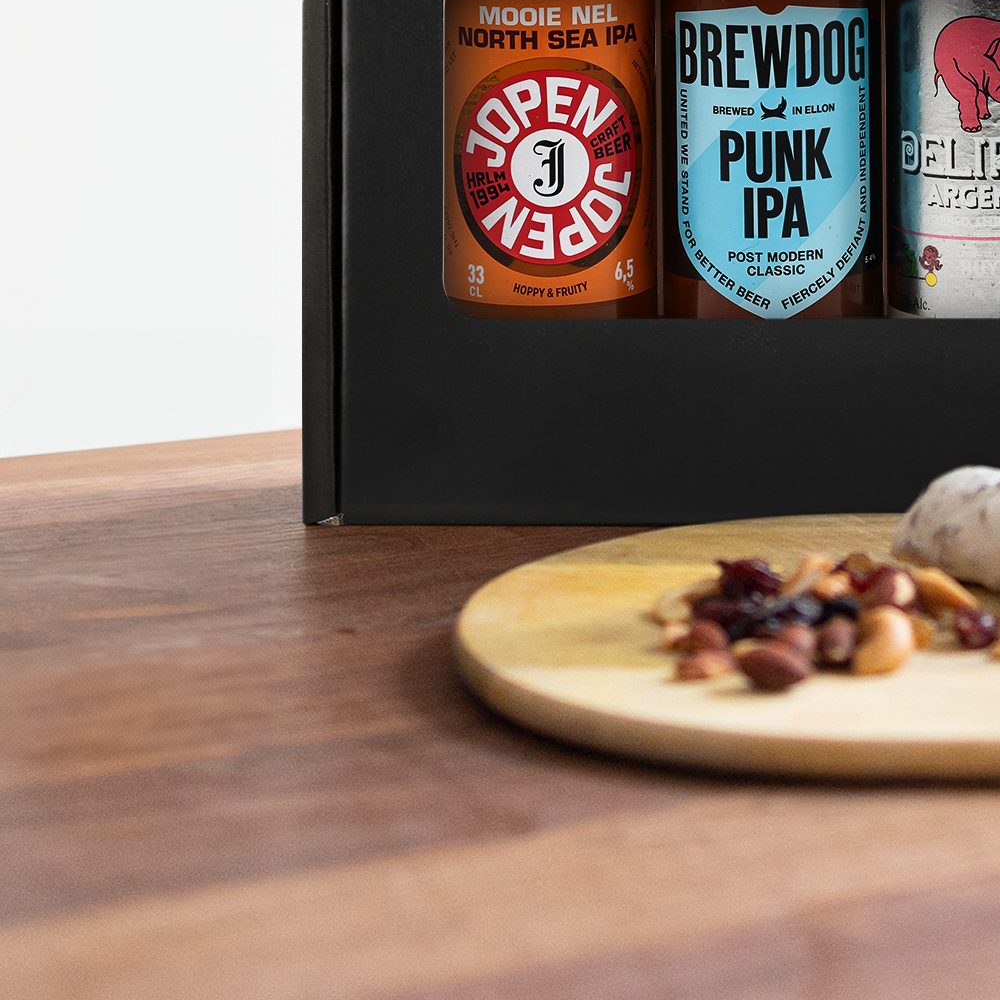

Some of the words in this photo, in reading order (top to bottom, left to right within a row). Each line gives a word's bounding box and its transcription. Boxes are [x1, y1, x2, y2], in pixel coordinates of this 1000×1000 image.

[478, 5, 562, 27] MOOIE
[571, 3, 618, 25] NEL
[458, 25, 538, 50] NORTH
[548, 28, 599, 50] SEA
[605, 23, 638, 46] IPA
[678, 16, 866, 89] BREWDOG
[466, 76, 618, 168] JOPEN
[679, 89, 689, 140] UNITED
[712, 105, 755, 117] BREWED
[792, 106, 802, 116] IN
[804, 103, 835, 115] ELLON
[589, 114, 627, 148] CRAFT
[592, 131, 632, 160] BEER
[858, 85, 867, 182] INDEPENDENT
[680, 144, 689, 165] WE
[719, 126, 833, 184] PUNK
[466, 171, 507, 189] HRLM
[681, 170, 690, 216] STAND
[469, 182, 511, 209] 1994
[858, 183, 867, 214] AND
[481, 162, 632, 260] JOPEN
[743, 186, 810, 239] IPA
[683, 220, 697, 249] FOR
[835, 218, 866, 271] DEFIANT
[614, 258, 634, 283] 6,5
[694, 248, 736, 292] BETTER
[728, 250, 763, 264] POST
[766, 248, 824, 263] MODERN
[746, 264, 806, 277] CLASSIC
[467, 263, 485, 284] 33
[626, 281, 635, 291] %
[469, 285, 483, 298] CL
[513, 282, 545, 298] HOPPY
[546, 287, 554, 297] &
[555, 281, 588, 297] FRUITY
[735, 286, 771, 310] BEER
[781, 267, 836, 310] FIERCELY
